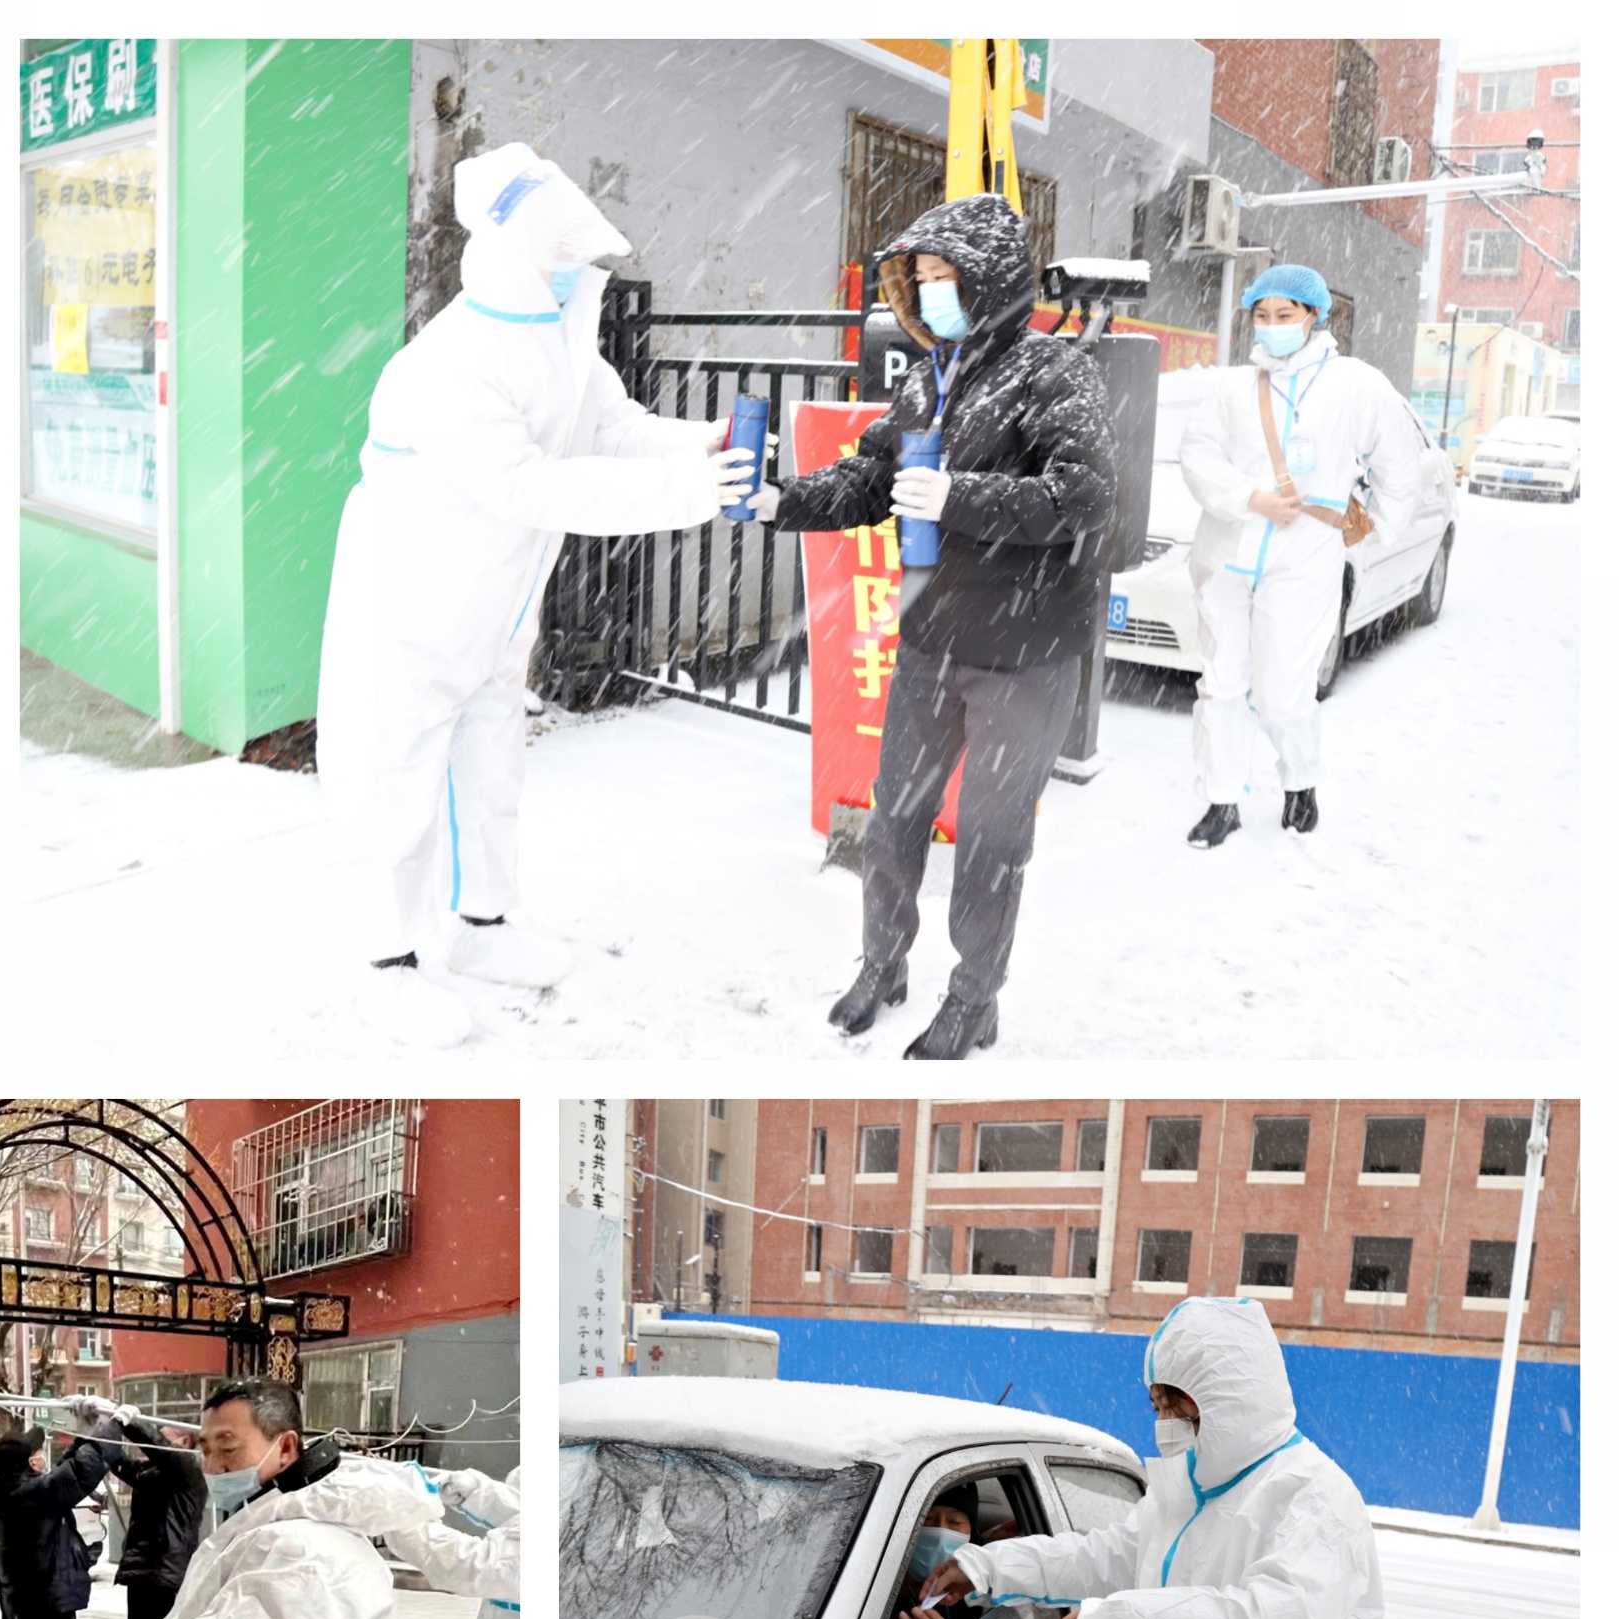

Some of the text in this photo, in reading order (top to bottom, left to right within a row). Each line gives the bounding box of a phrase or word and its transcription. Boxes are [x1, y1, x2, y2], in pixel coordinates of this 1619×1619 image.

[29, 39, 138, 138] 医保刷
[884, 351, 908, 389] P
